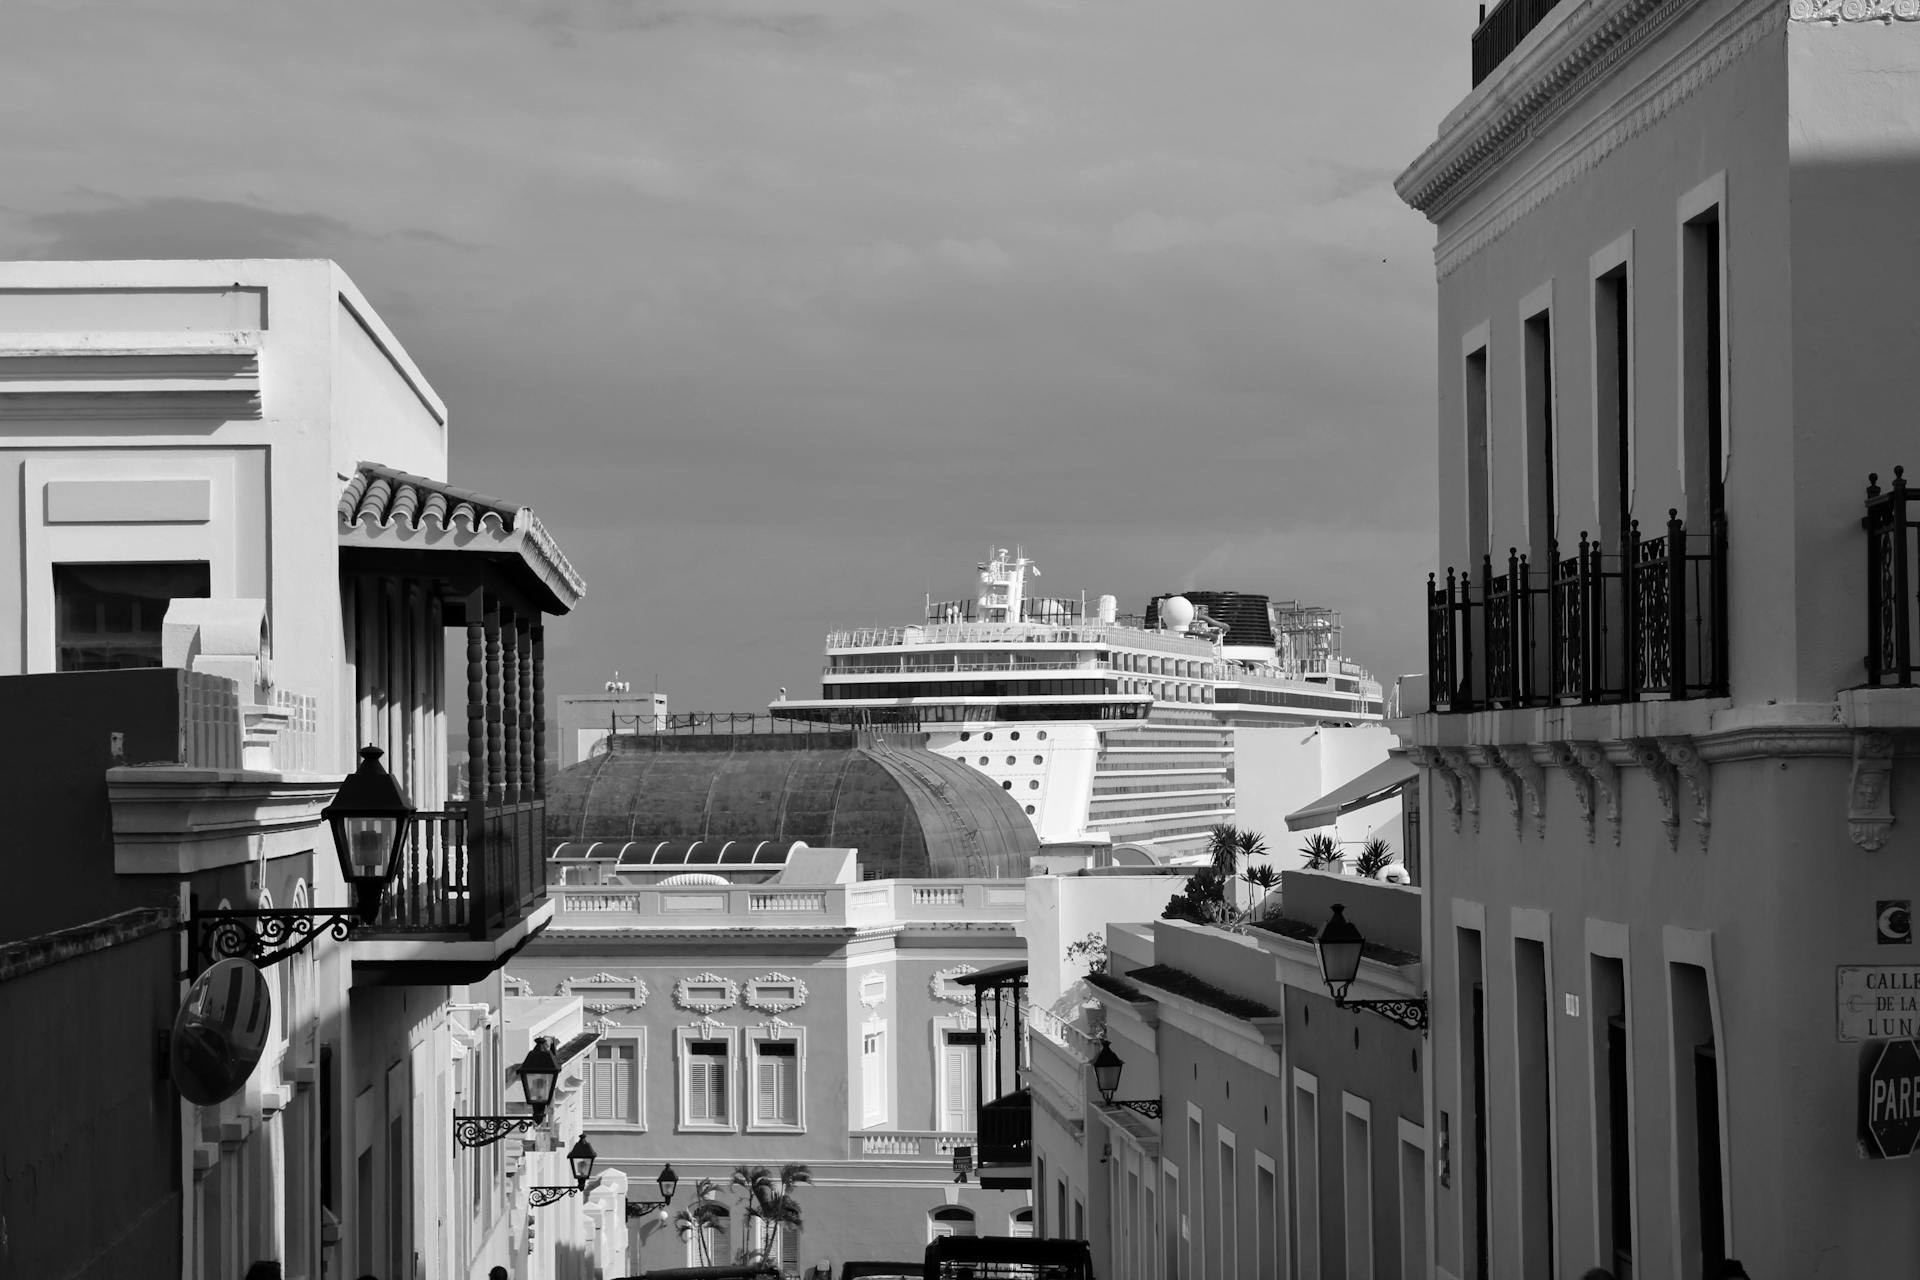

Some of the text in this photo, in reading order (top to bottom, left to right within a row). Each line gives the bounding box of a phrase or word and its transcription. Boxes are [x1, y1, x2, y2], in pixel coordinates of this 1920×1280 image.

[1866, 972, 1920, 990] CALLE
[1877, 996, 1917, 1011] DE LA
[1873, 1075, 1920, 1122] PARE
